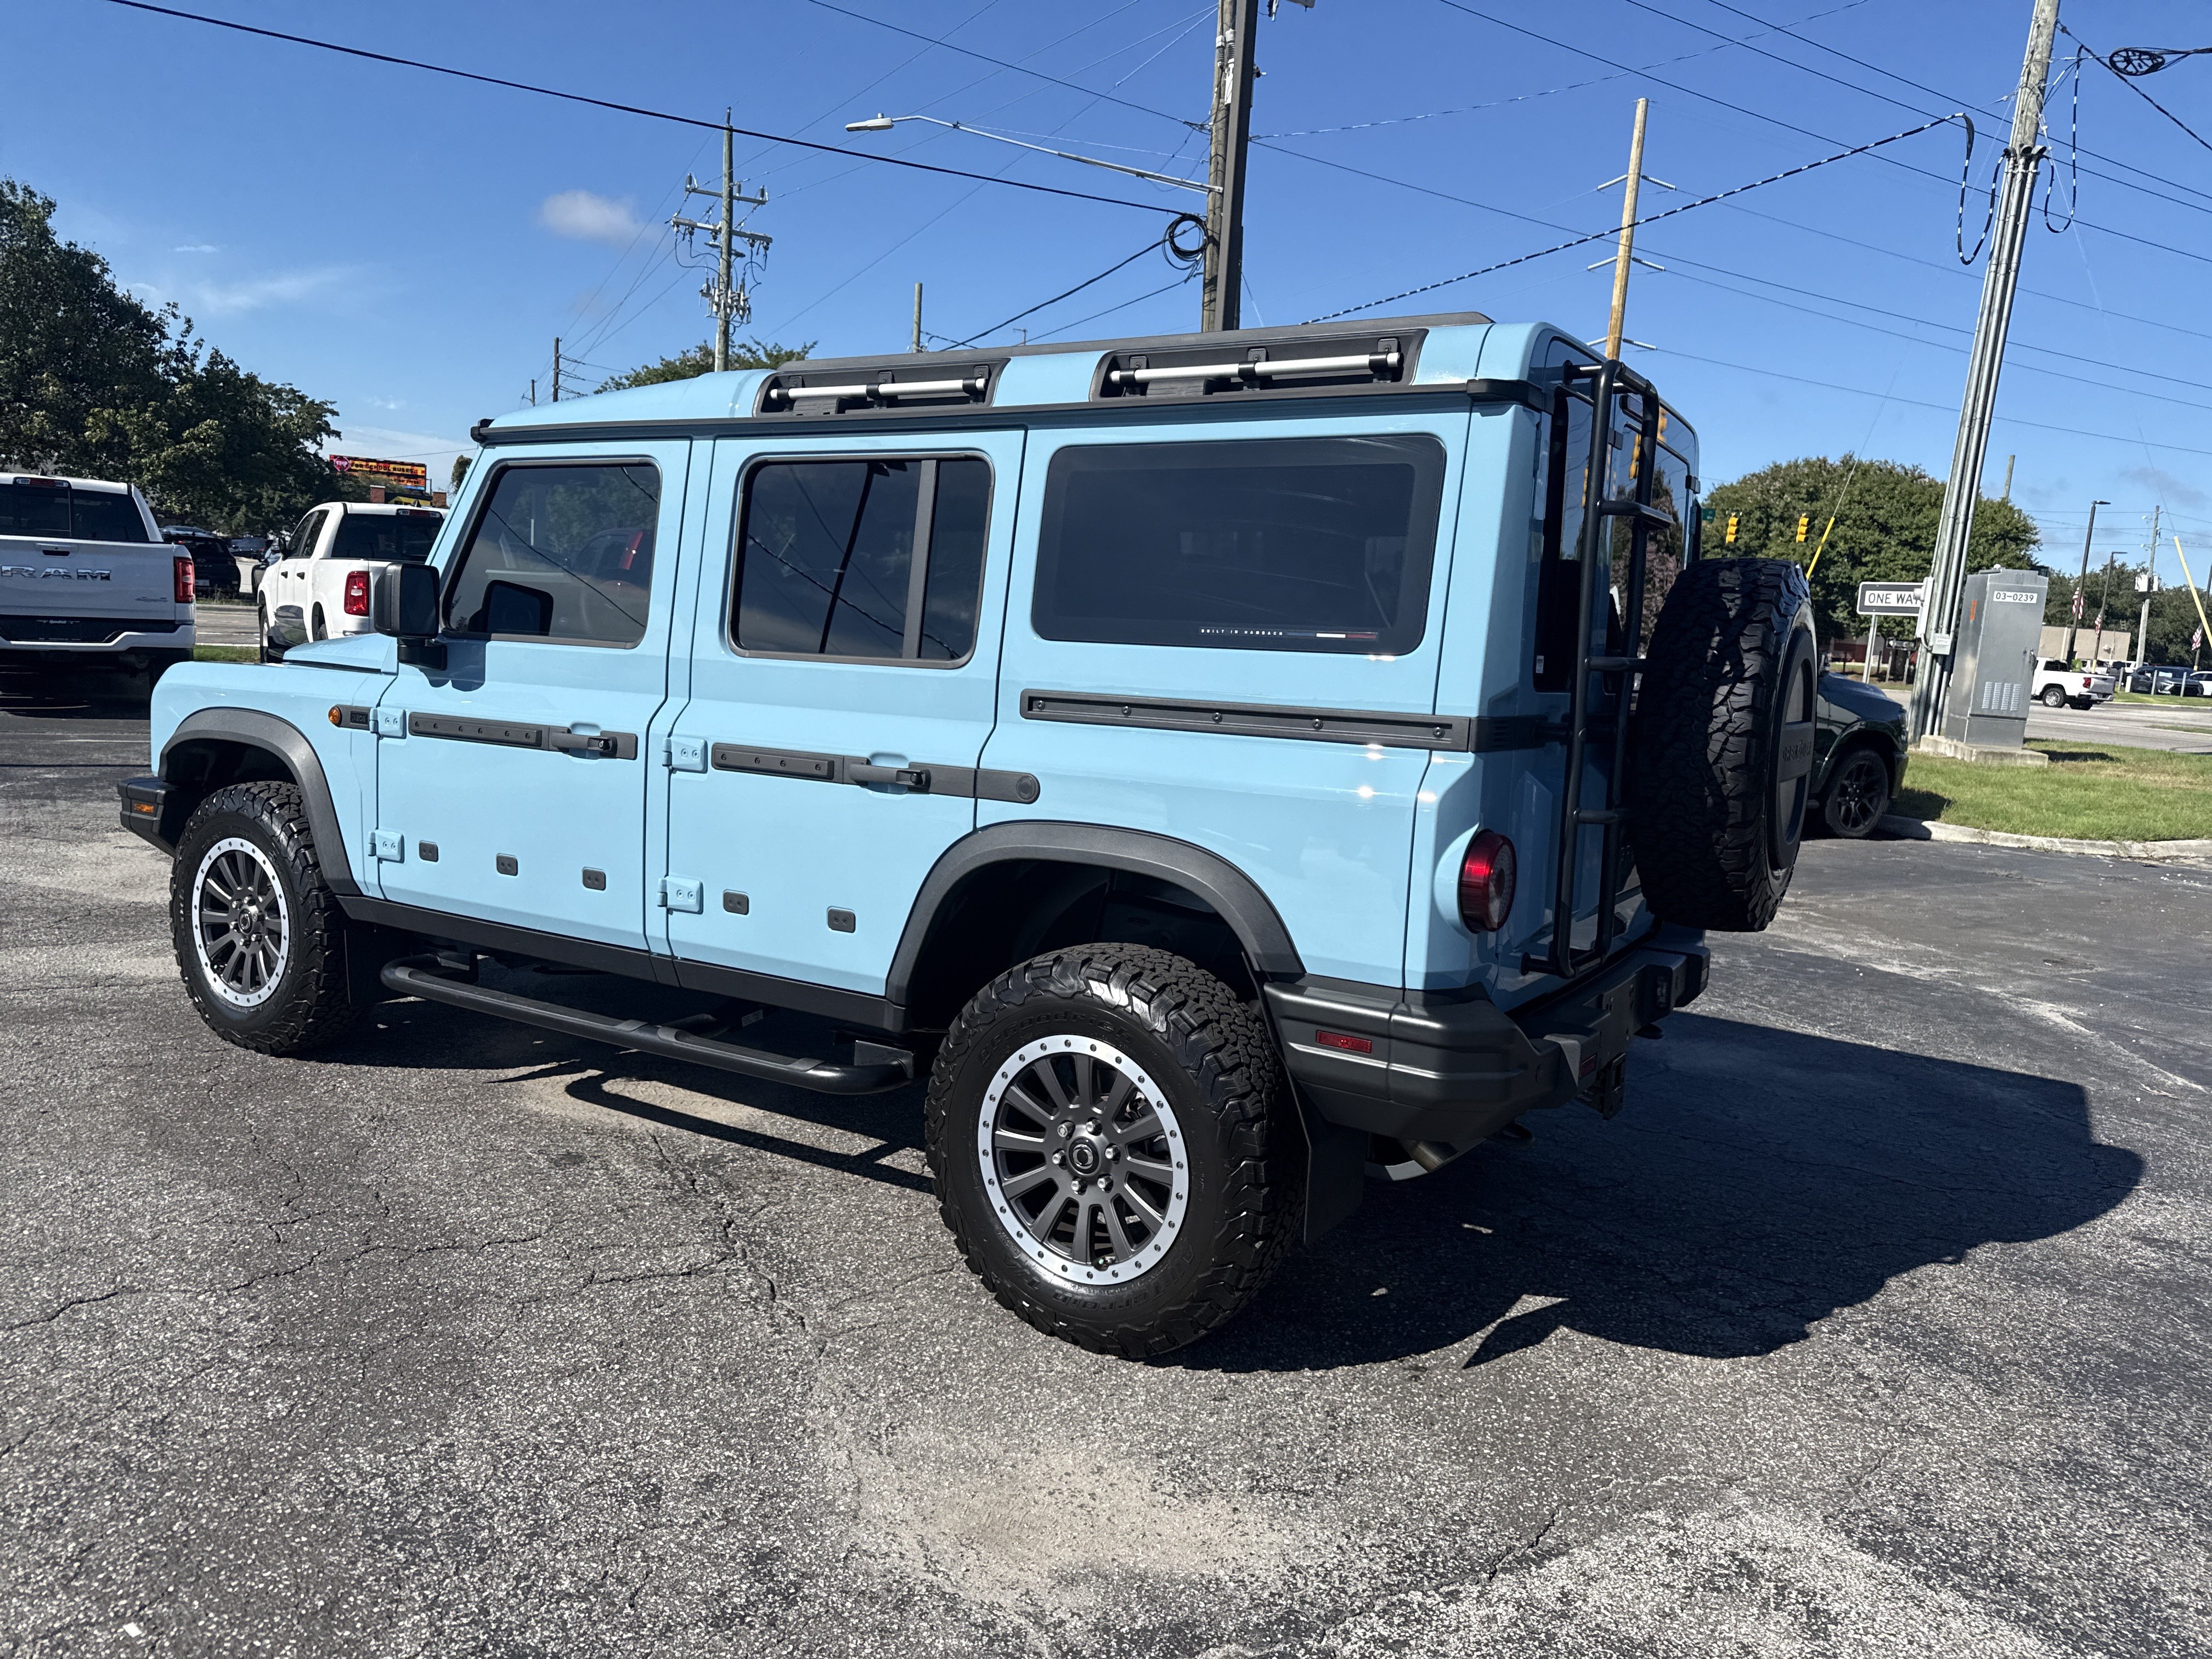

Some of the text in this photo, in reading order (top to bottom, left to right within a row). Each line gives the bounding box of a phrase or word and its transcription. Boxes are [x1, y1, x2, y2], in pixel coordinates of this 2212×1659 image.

[1, 566, 111, 580] RAM
[1869, 592, 1892, 604] ONE
[1996, 592, 2034, 601] 03-0239
